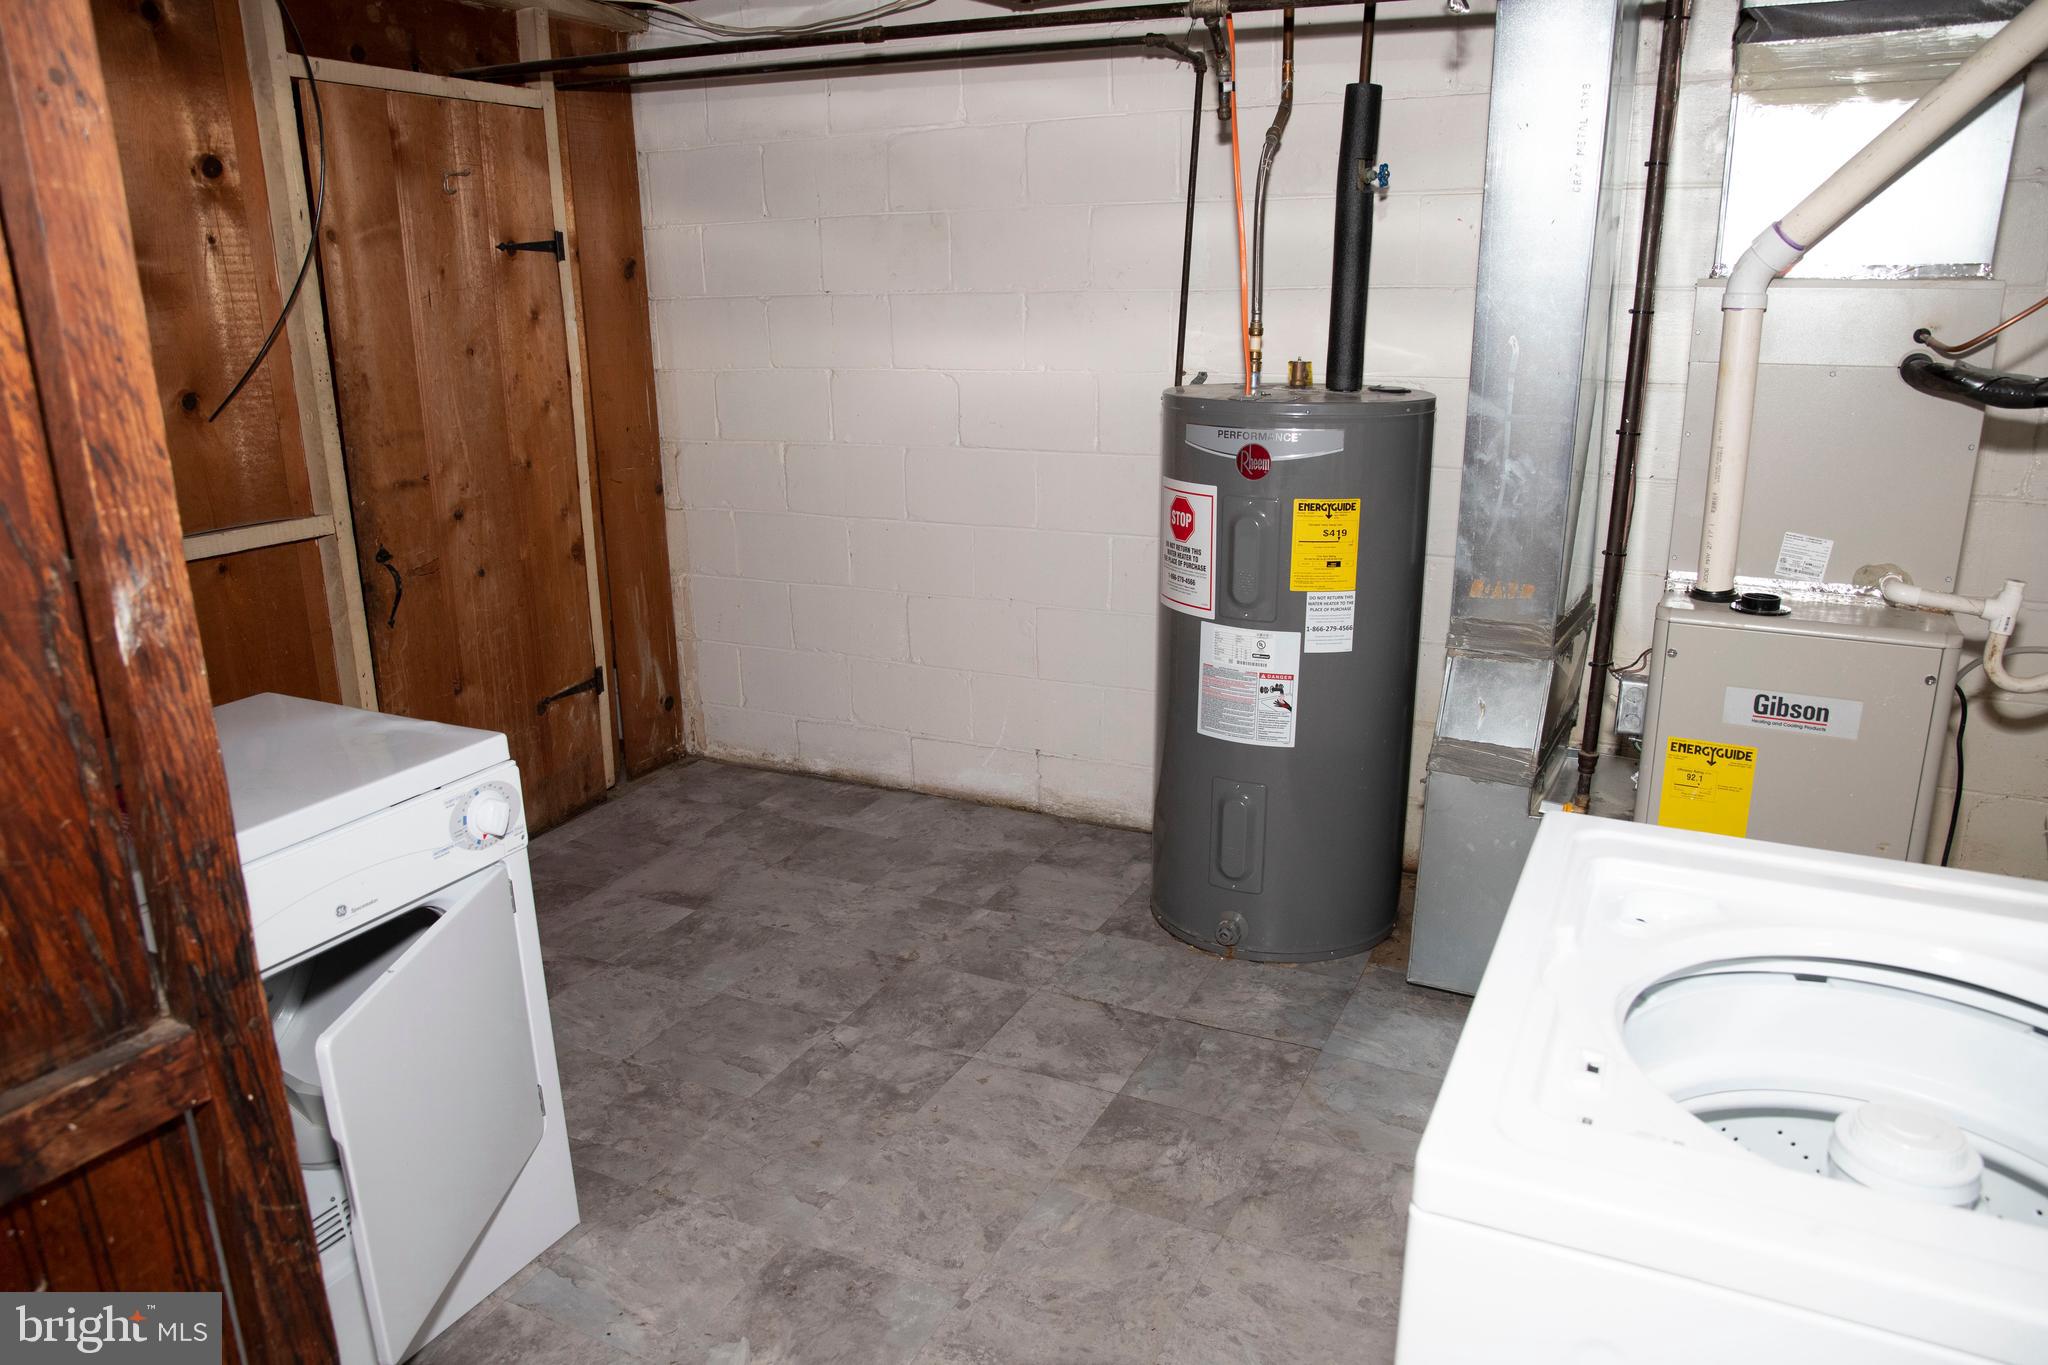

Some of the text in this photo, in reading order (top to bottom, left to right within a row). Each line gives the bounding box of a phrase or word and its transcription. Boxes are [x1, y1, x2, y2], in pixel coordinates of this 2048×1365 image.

[1217, 429, 1300, 442] PERFORMANCE
[1240, 444, 1270, 475] Rheem
[1298, 502, 1356, 512] ENERGYGUIDE
[1172, 510, 1192, 528] STOP
[1754, 694, 1830, 722] Gibson
[1670, 742, 1753, 762] ENERGYGUIDE
[1686, 774, 1703, 782] 92.1
